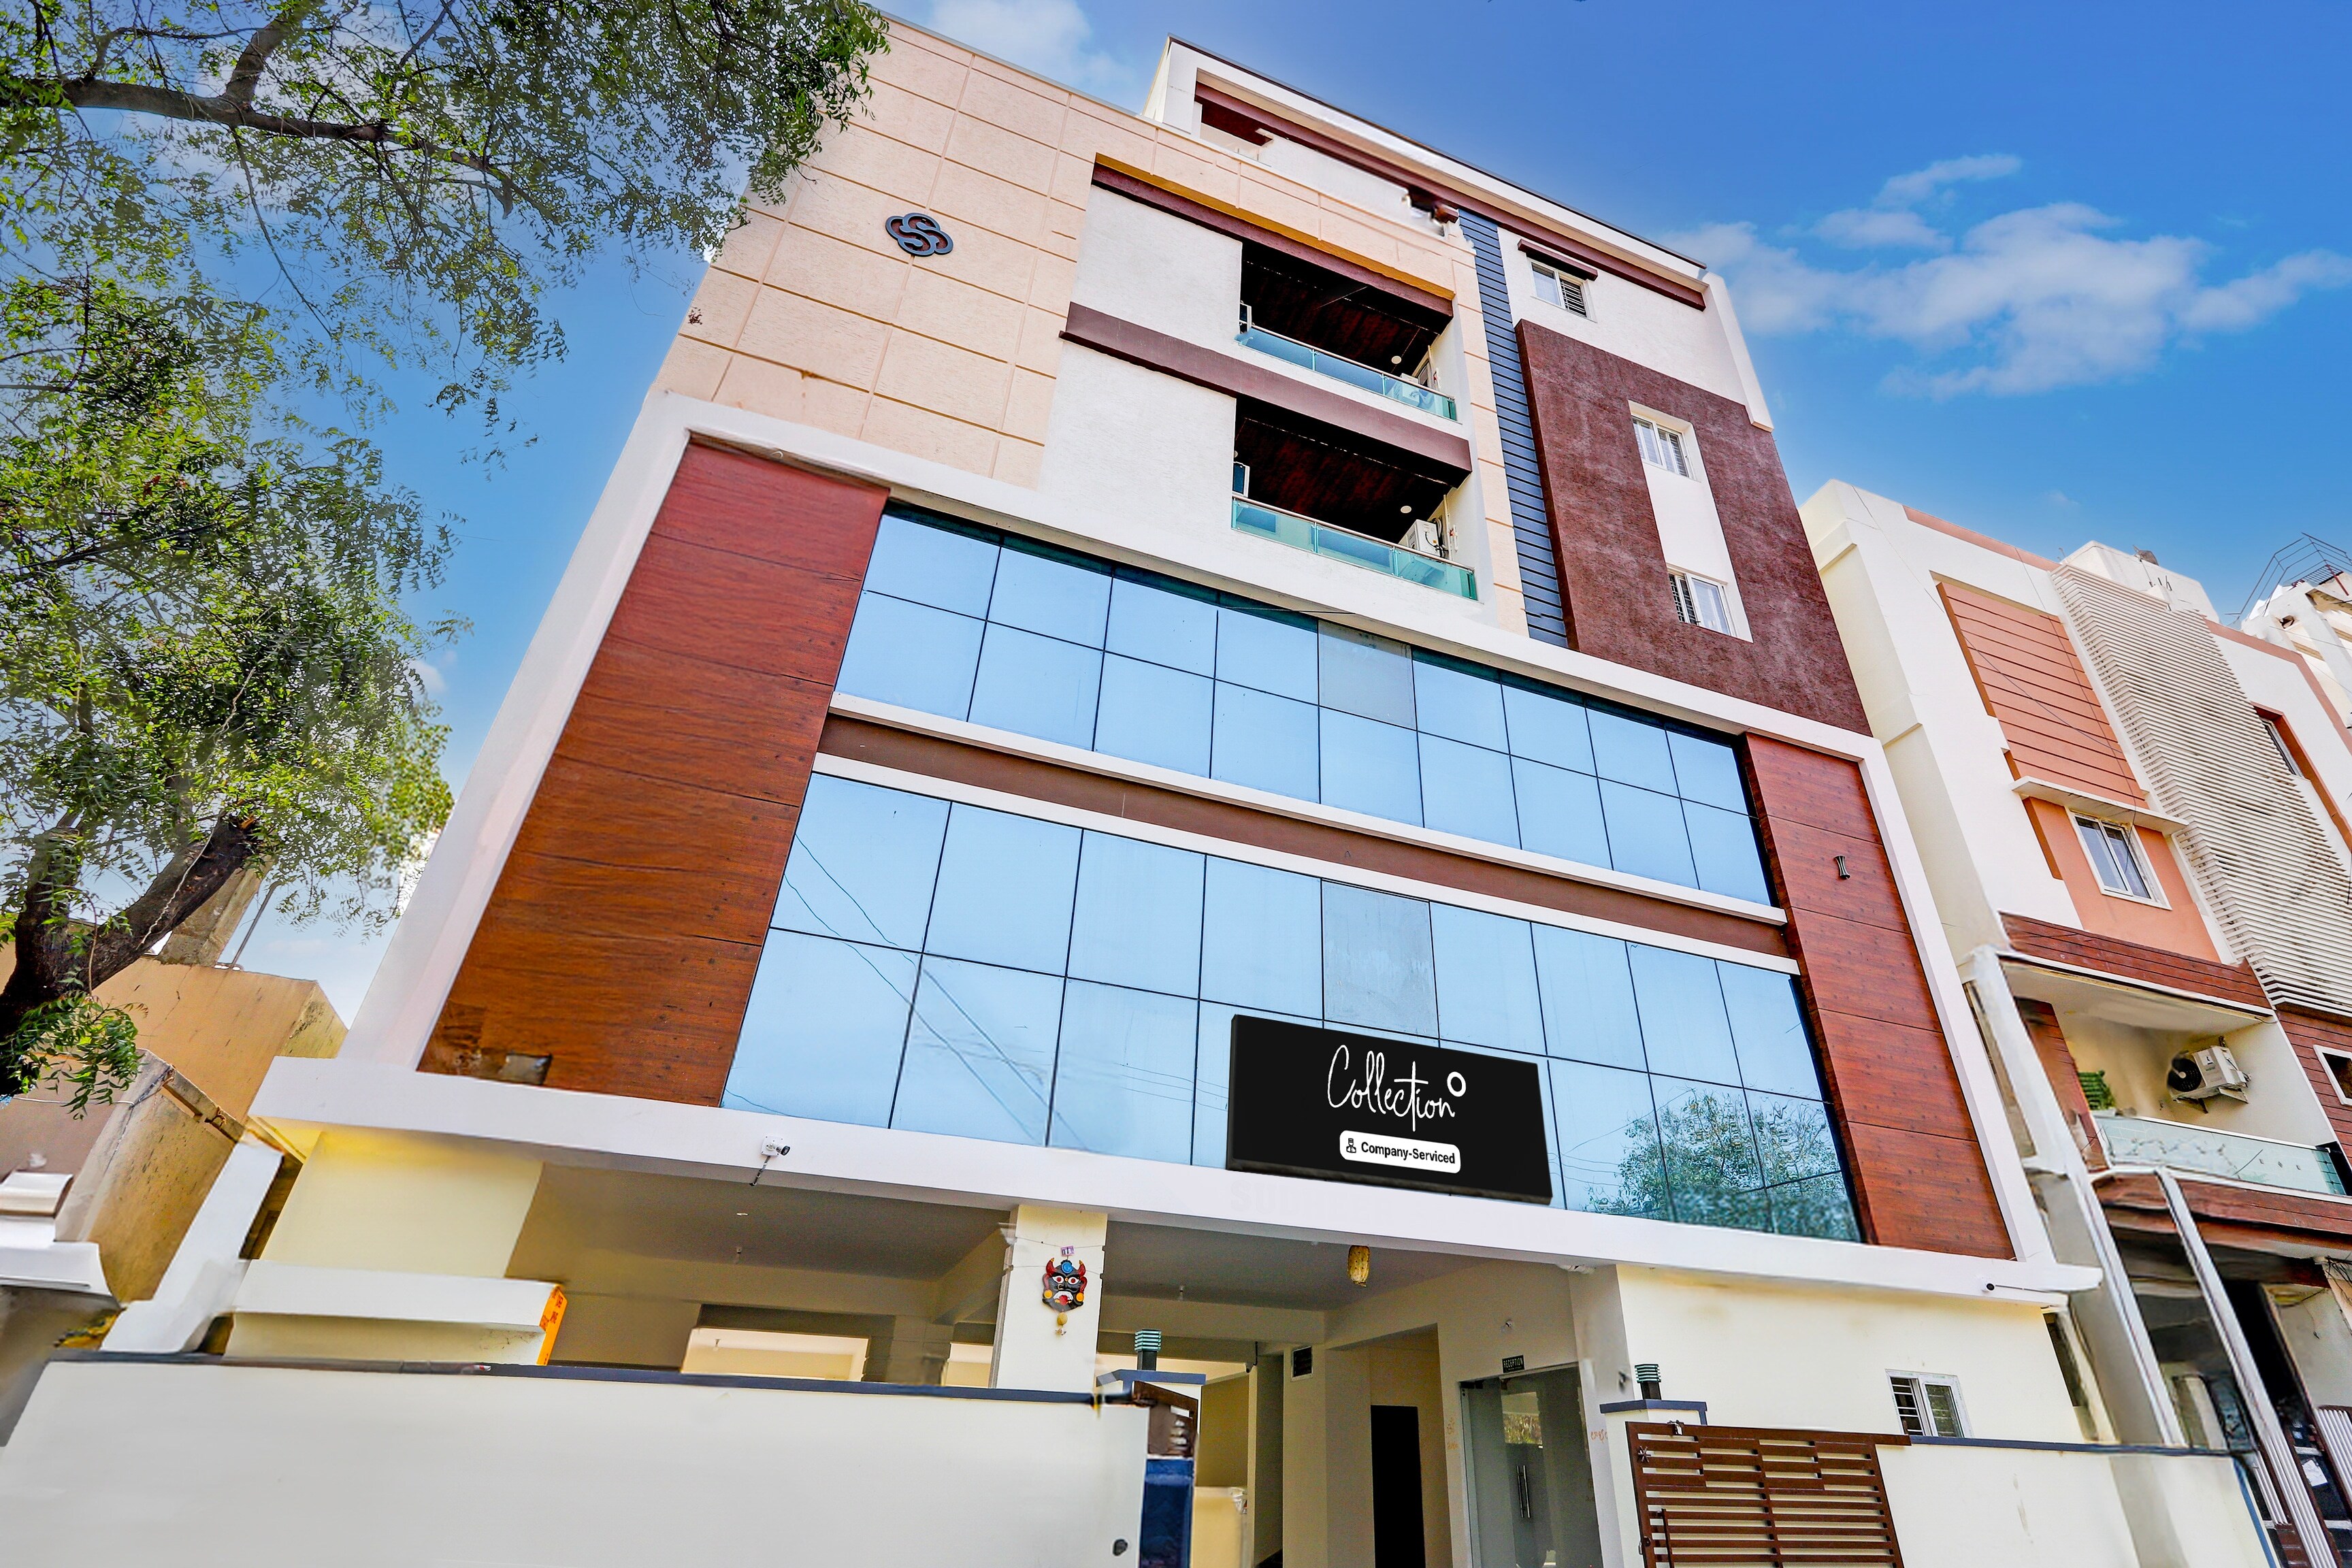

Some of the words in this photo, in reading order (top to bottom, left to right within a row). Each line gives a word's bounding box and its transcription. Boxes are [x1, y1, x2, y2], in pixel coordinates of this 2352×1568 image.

[1327, 1044, 1456, 1132] Collection
[1360, 1141, 1456, 1164] Company-Serviced
[1503, 1357, 1524, 1369] RECEPTION
